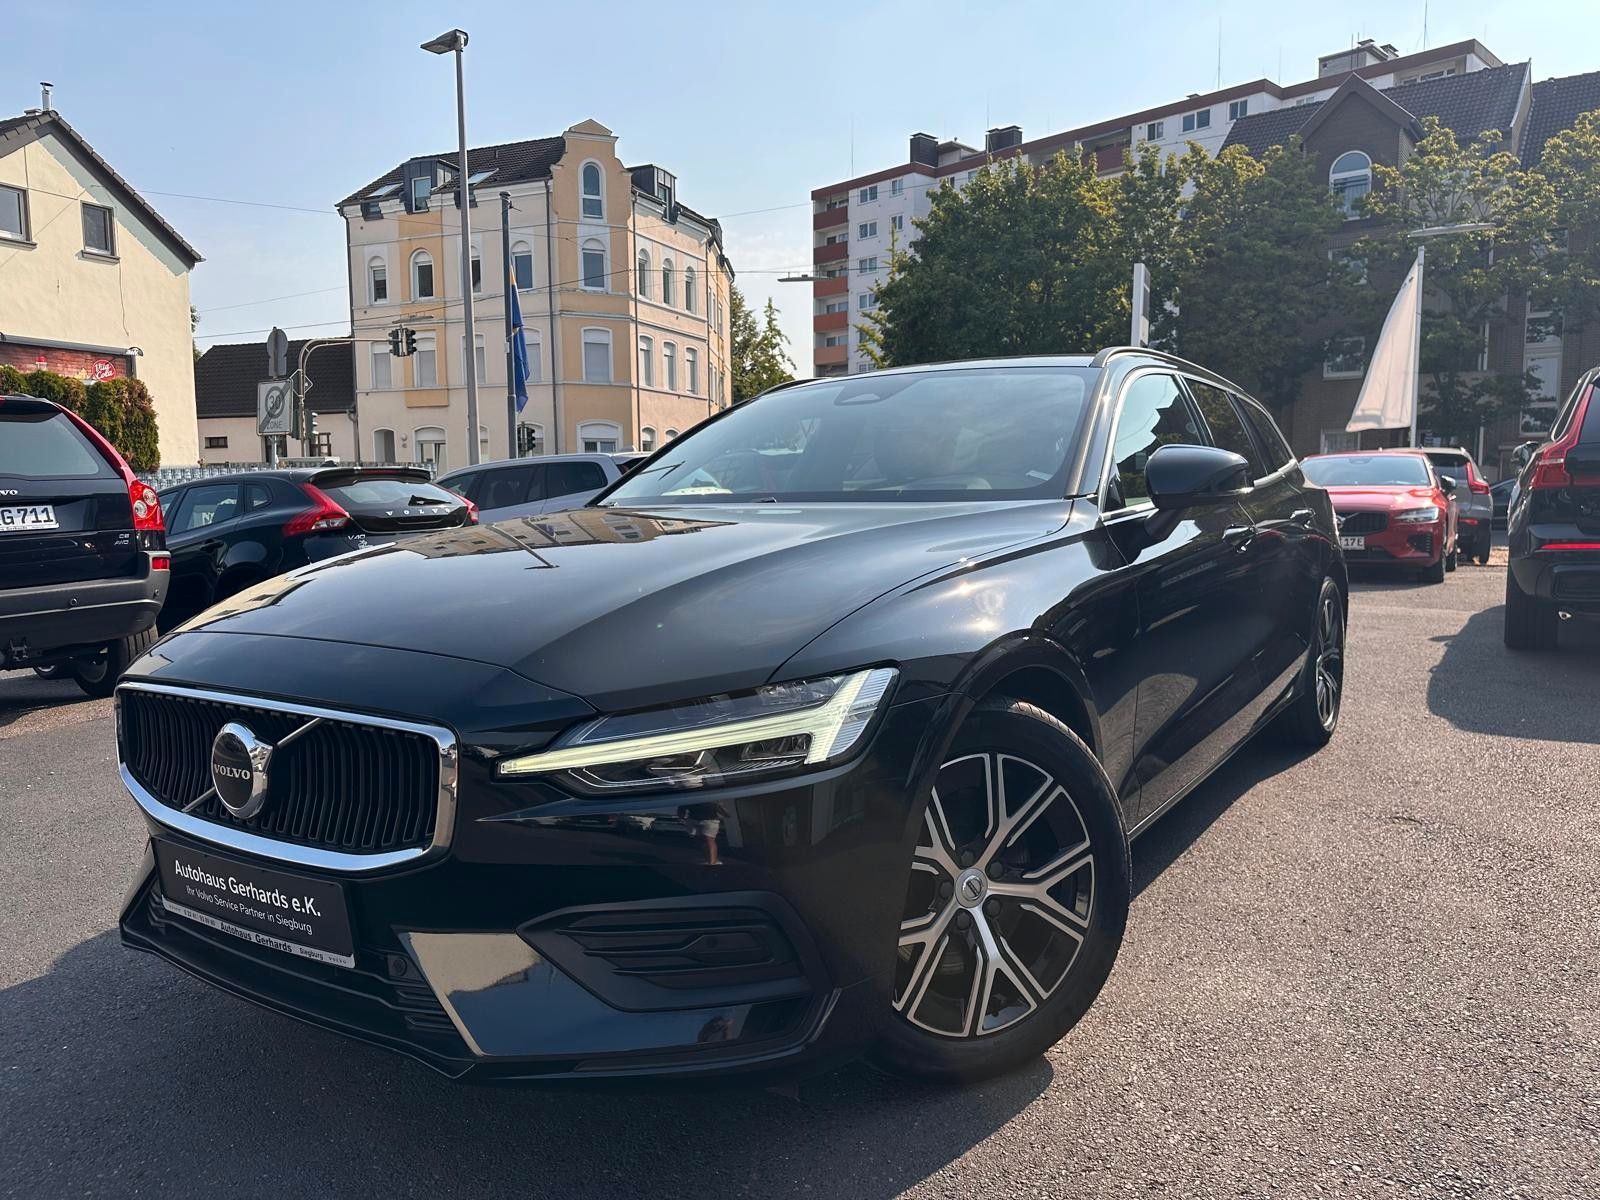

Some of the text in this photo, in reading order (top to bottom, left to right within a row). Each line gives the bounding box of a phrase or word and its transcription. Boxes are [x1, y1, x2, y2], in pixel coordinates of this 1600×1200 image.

[96, 370, 114, 379] Cola
[269, 395, 281, 410] 30
[17, 507, 54, 524] 711
[214, 763, 251, 780] VOLVO
[175, 859, 321, 917] Autohaus Gerhards e.K.
[186, 884, 313, 936] Ihr Volvo Service Partner in Siegburg
[220, 922, 252, 941] Autohaus
[255, 934, 293, 953] Gerhards
[299, 947, 324, 961] Siegburg
